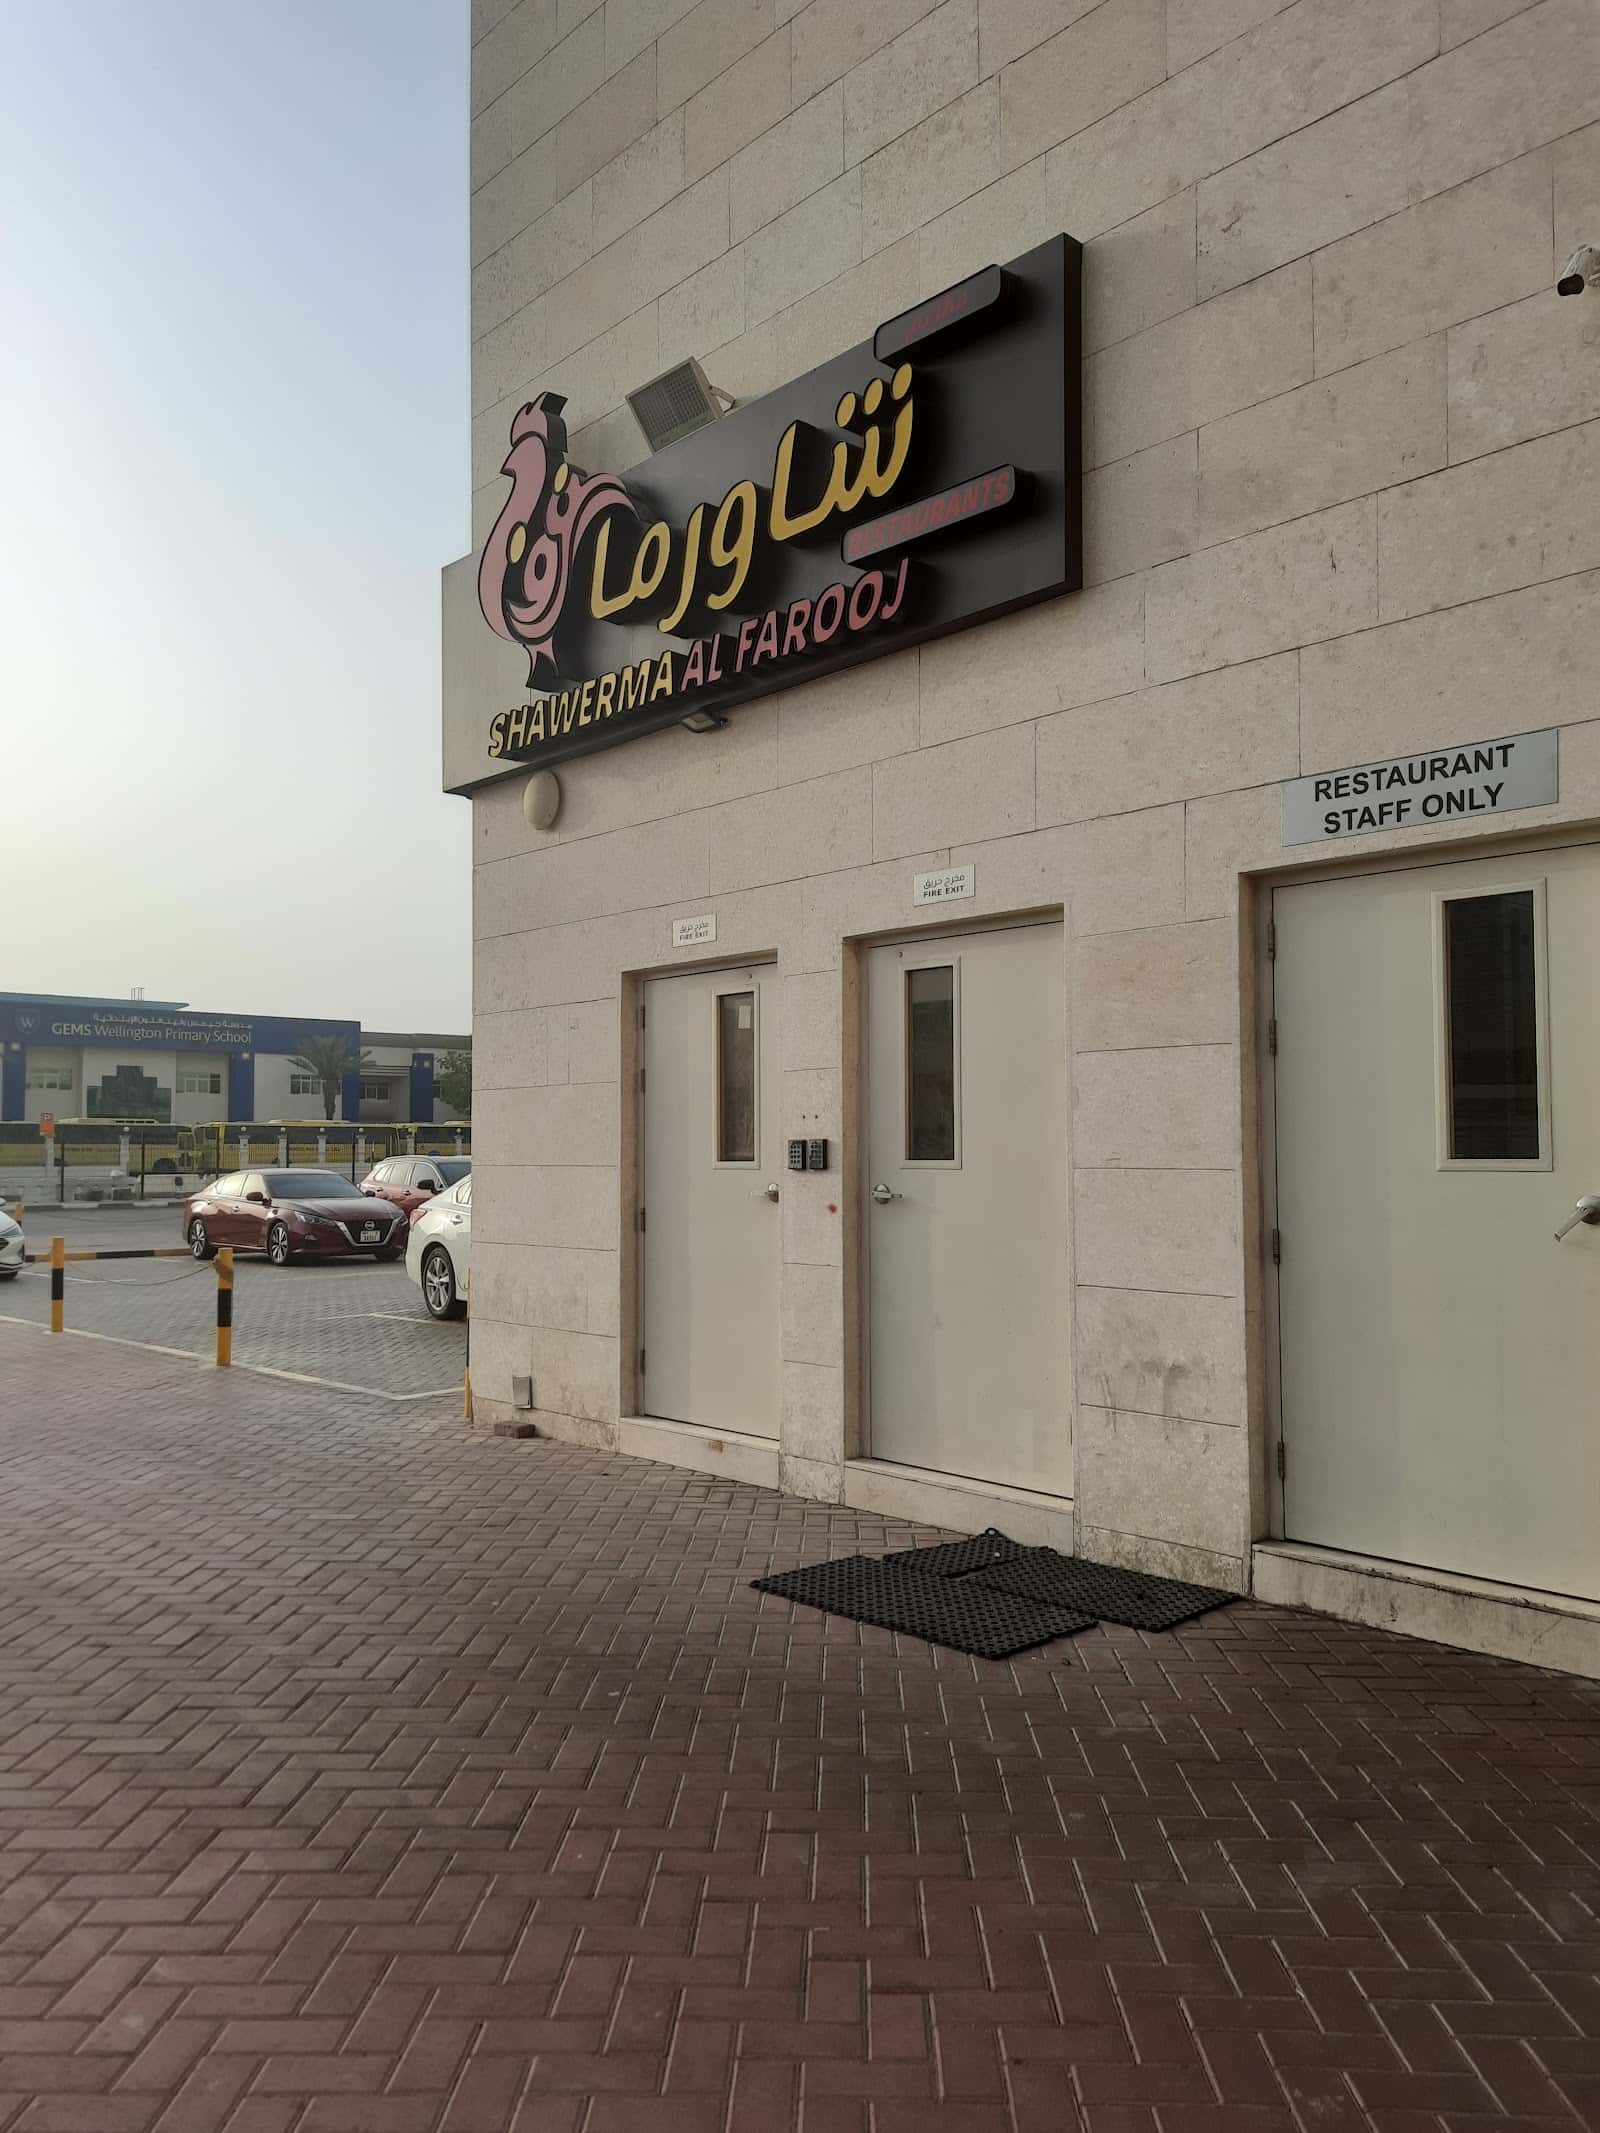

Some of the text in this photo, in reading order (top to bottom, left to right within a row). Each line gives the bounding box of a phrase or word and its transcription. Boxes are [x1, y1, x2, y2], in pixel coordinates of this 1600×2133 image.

[590, 362, 913, 633] شاورما
[848, 469, 1010, 556] RESTAURANTS
[488, 558, 909, 759] SHAWERMA AL FAROOJ
[1314, 743, 1515, 802] RESTAURANT
[1324, 782, 1504, 834] STAFF ONLY
[923, 885, 964, 898] FIRE EXIT
[51, 1022, 252, 1044] GEMS Wellington Primary School
